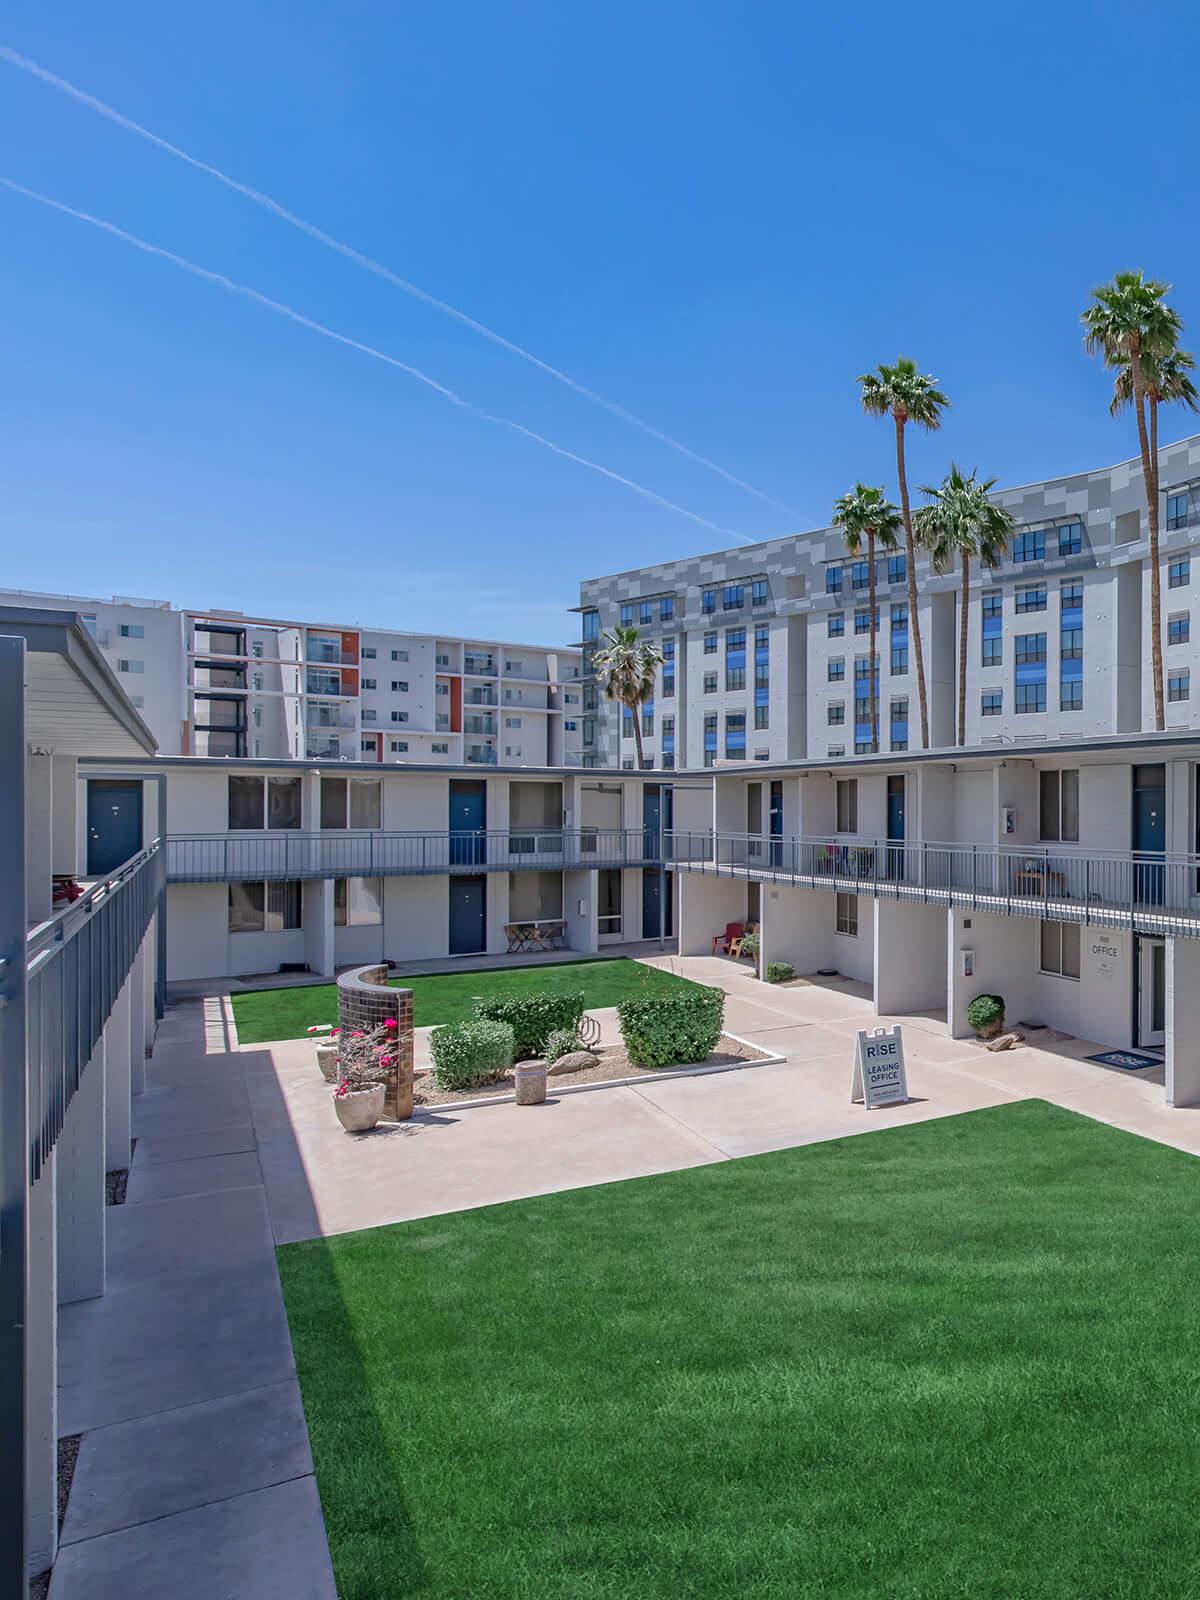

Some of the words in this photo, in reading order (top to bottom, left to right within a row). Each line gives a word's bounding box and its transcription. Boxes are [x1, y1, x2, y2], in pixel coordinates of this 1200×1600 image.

[1092, 945, 1118, 957] OFFICE
[867, 1043, 896, 1058] RISE
[867, 1062, 899, 1074] LEASING
[870, 1071, 898, 1082] OFFICE
